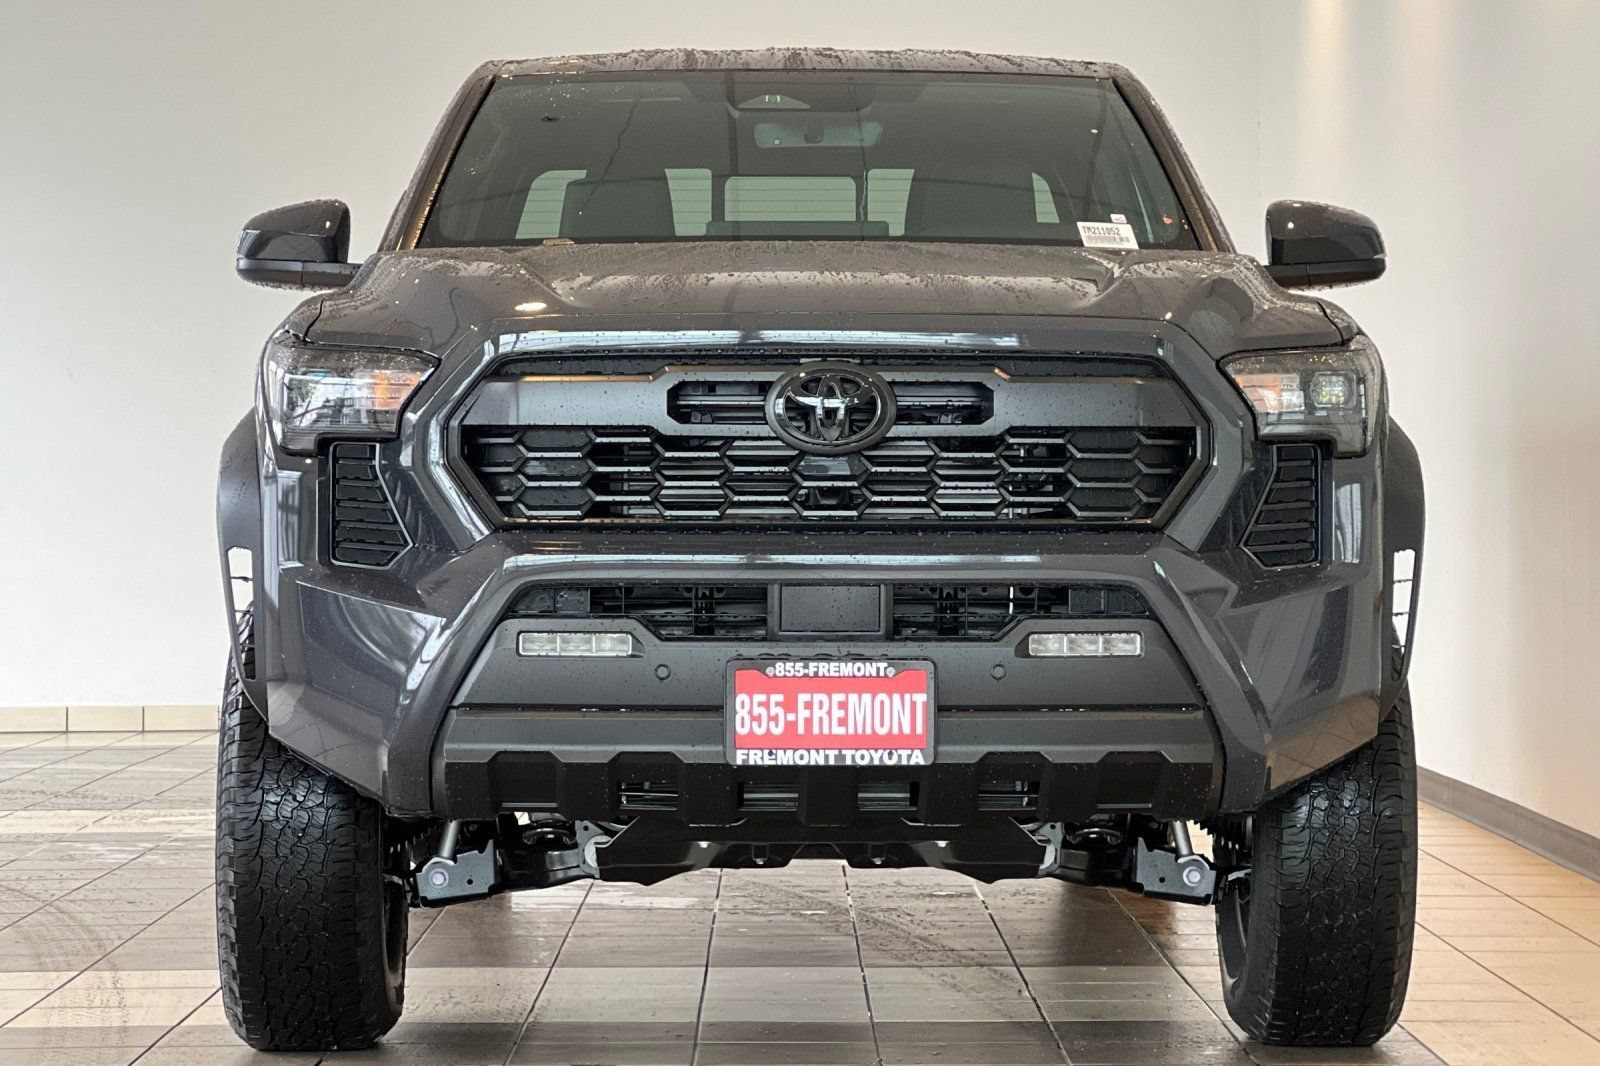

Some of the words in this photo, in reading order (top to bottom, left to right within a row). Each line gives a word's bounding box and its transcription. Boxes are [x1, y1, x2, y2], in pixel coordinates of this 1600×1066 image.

[775, 662, 888, 677] 855-FREMONT
[735, 693, 928, 735] 855-FREMONT
[736, 750, 840, 765] FREMONT
[842, 750, 925, 765] TOYOTA
